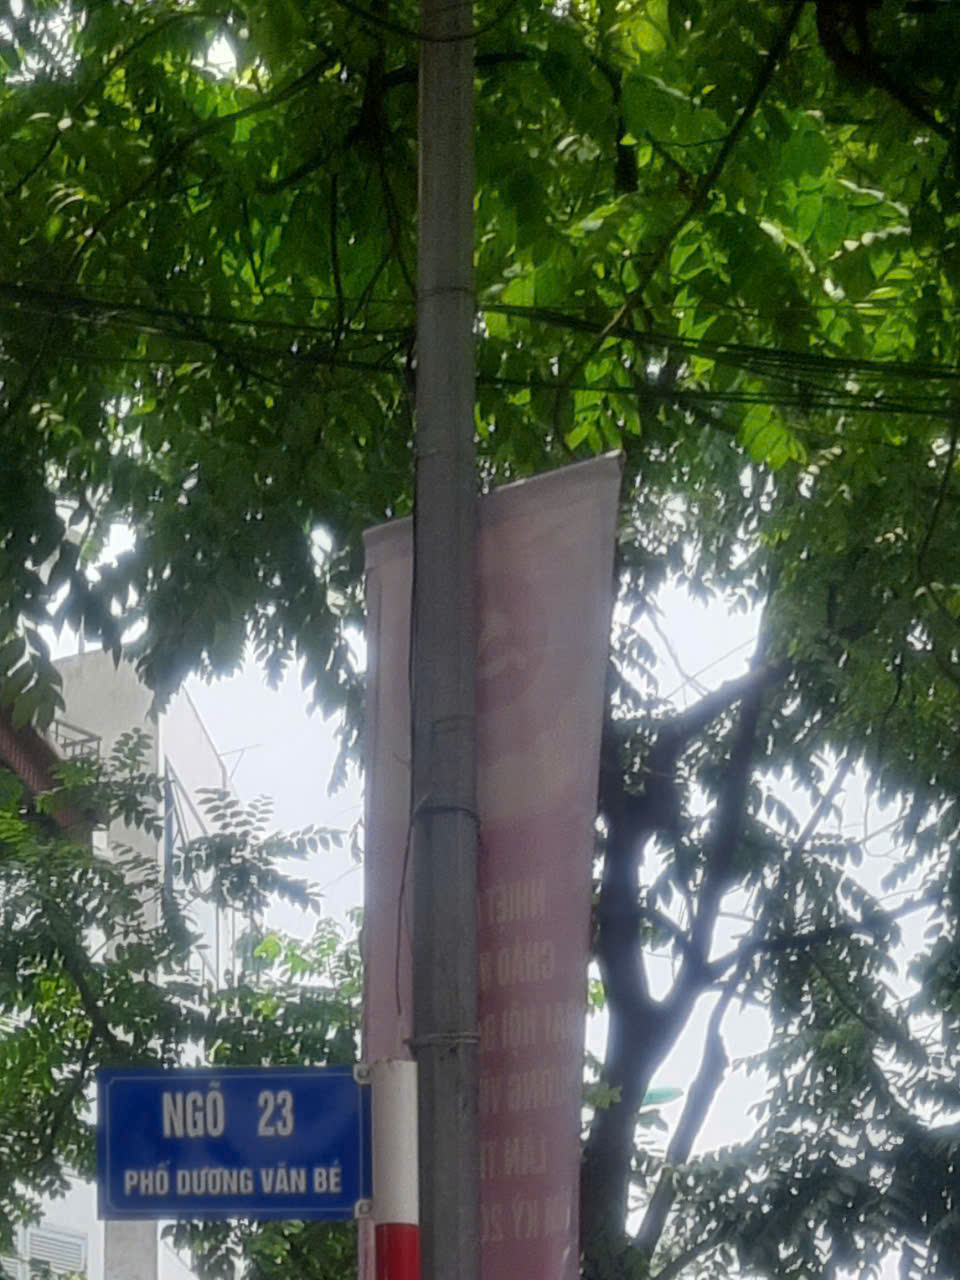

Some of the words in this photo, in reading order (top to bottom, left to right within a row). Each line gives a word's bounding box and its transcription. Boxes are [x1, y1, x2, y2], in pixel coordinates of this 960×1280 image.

[161, 1081, 226, 1138] NGÕ
[257, 1090, 295, 1137] 23
[123, 1160, 170, 1197] PHỐ
[176, 1165, 254, 1196] DƯƠNG
[259, 1161, 307, 1194] VĂN
[313, 1160, 343, 1193] BÉ
